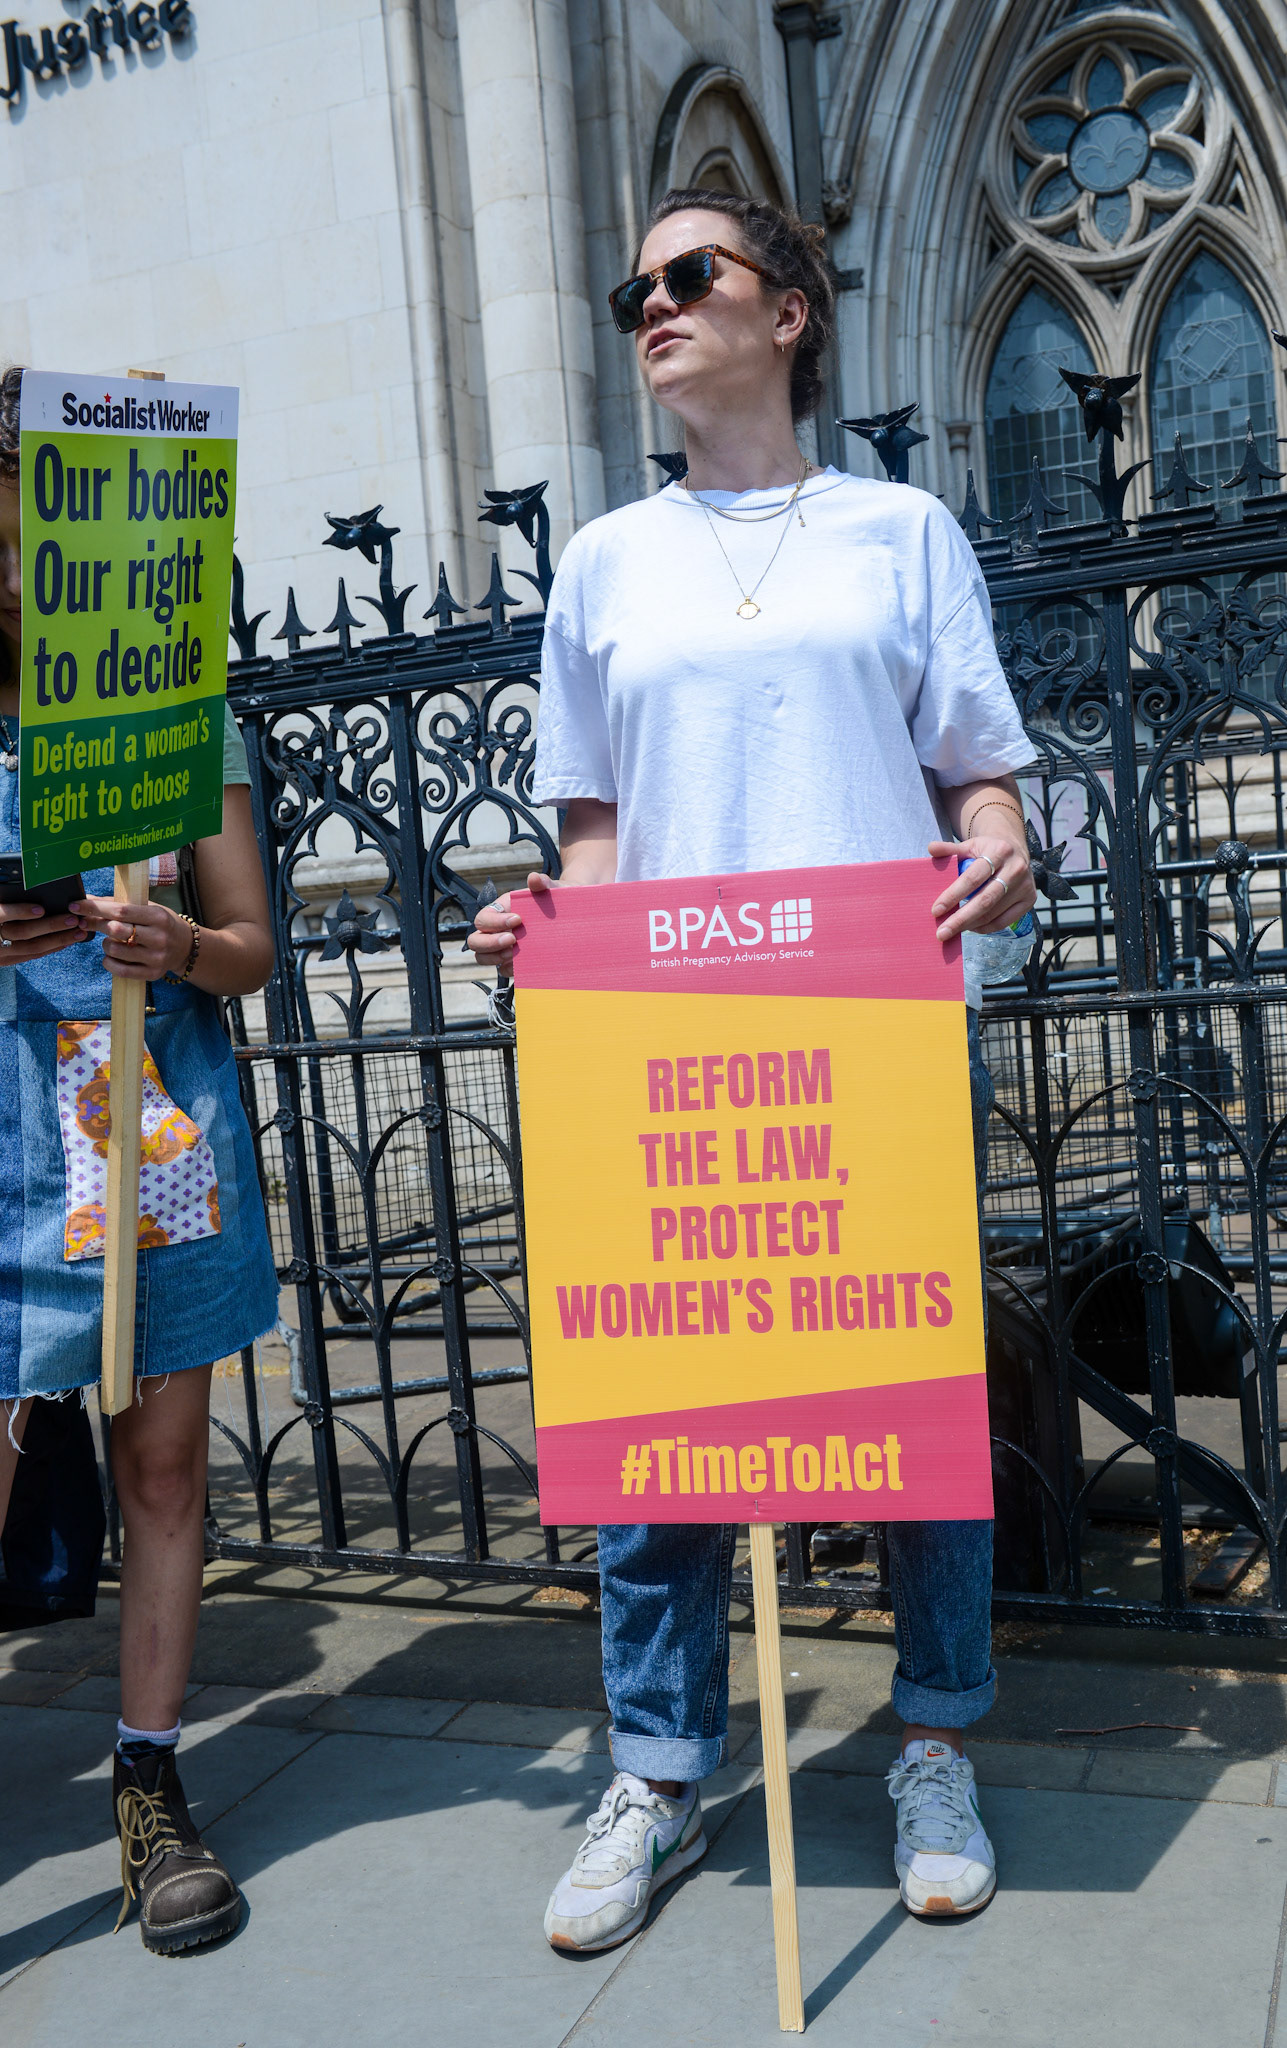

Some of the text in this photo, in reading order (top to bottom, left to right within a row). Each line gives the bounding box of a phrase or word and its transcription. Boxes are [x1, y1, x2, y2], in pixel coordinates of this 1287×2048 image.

[0, 0, 188, 100] Justice
[34, 443, 229, 522] Our bodies
[34, 537, 204, 624] Our right
[33, 621, 202, 707] to decide
[32, 708, 210, 777] Defend a woman's
[32, 768, 190, 834] right to choose
[93, 818, 184, 855] socialistworker.co.uk
[648, 902, 765, 953] BPAS
[650, 948, 815, 969] British Pregnancy Advisory Service
[646, 1048, 833, 1113] REFORM
[638, 1124, 849, 1188] THE LAW,
[650, 1199, 844, 1262] PROTECT
[555, 1271, 953, 1340] WOMEN'S RIGHTS
[620, 1434, 904, 1495] #TimeToAct
